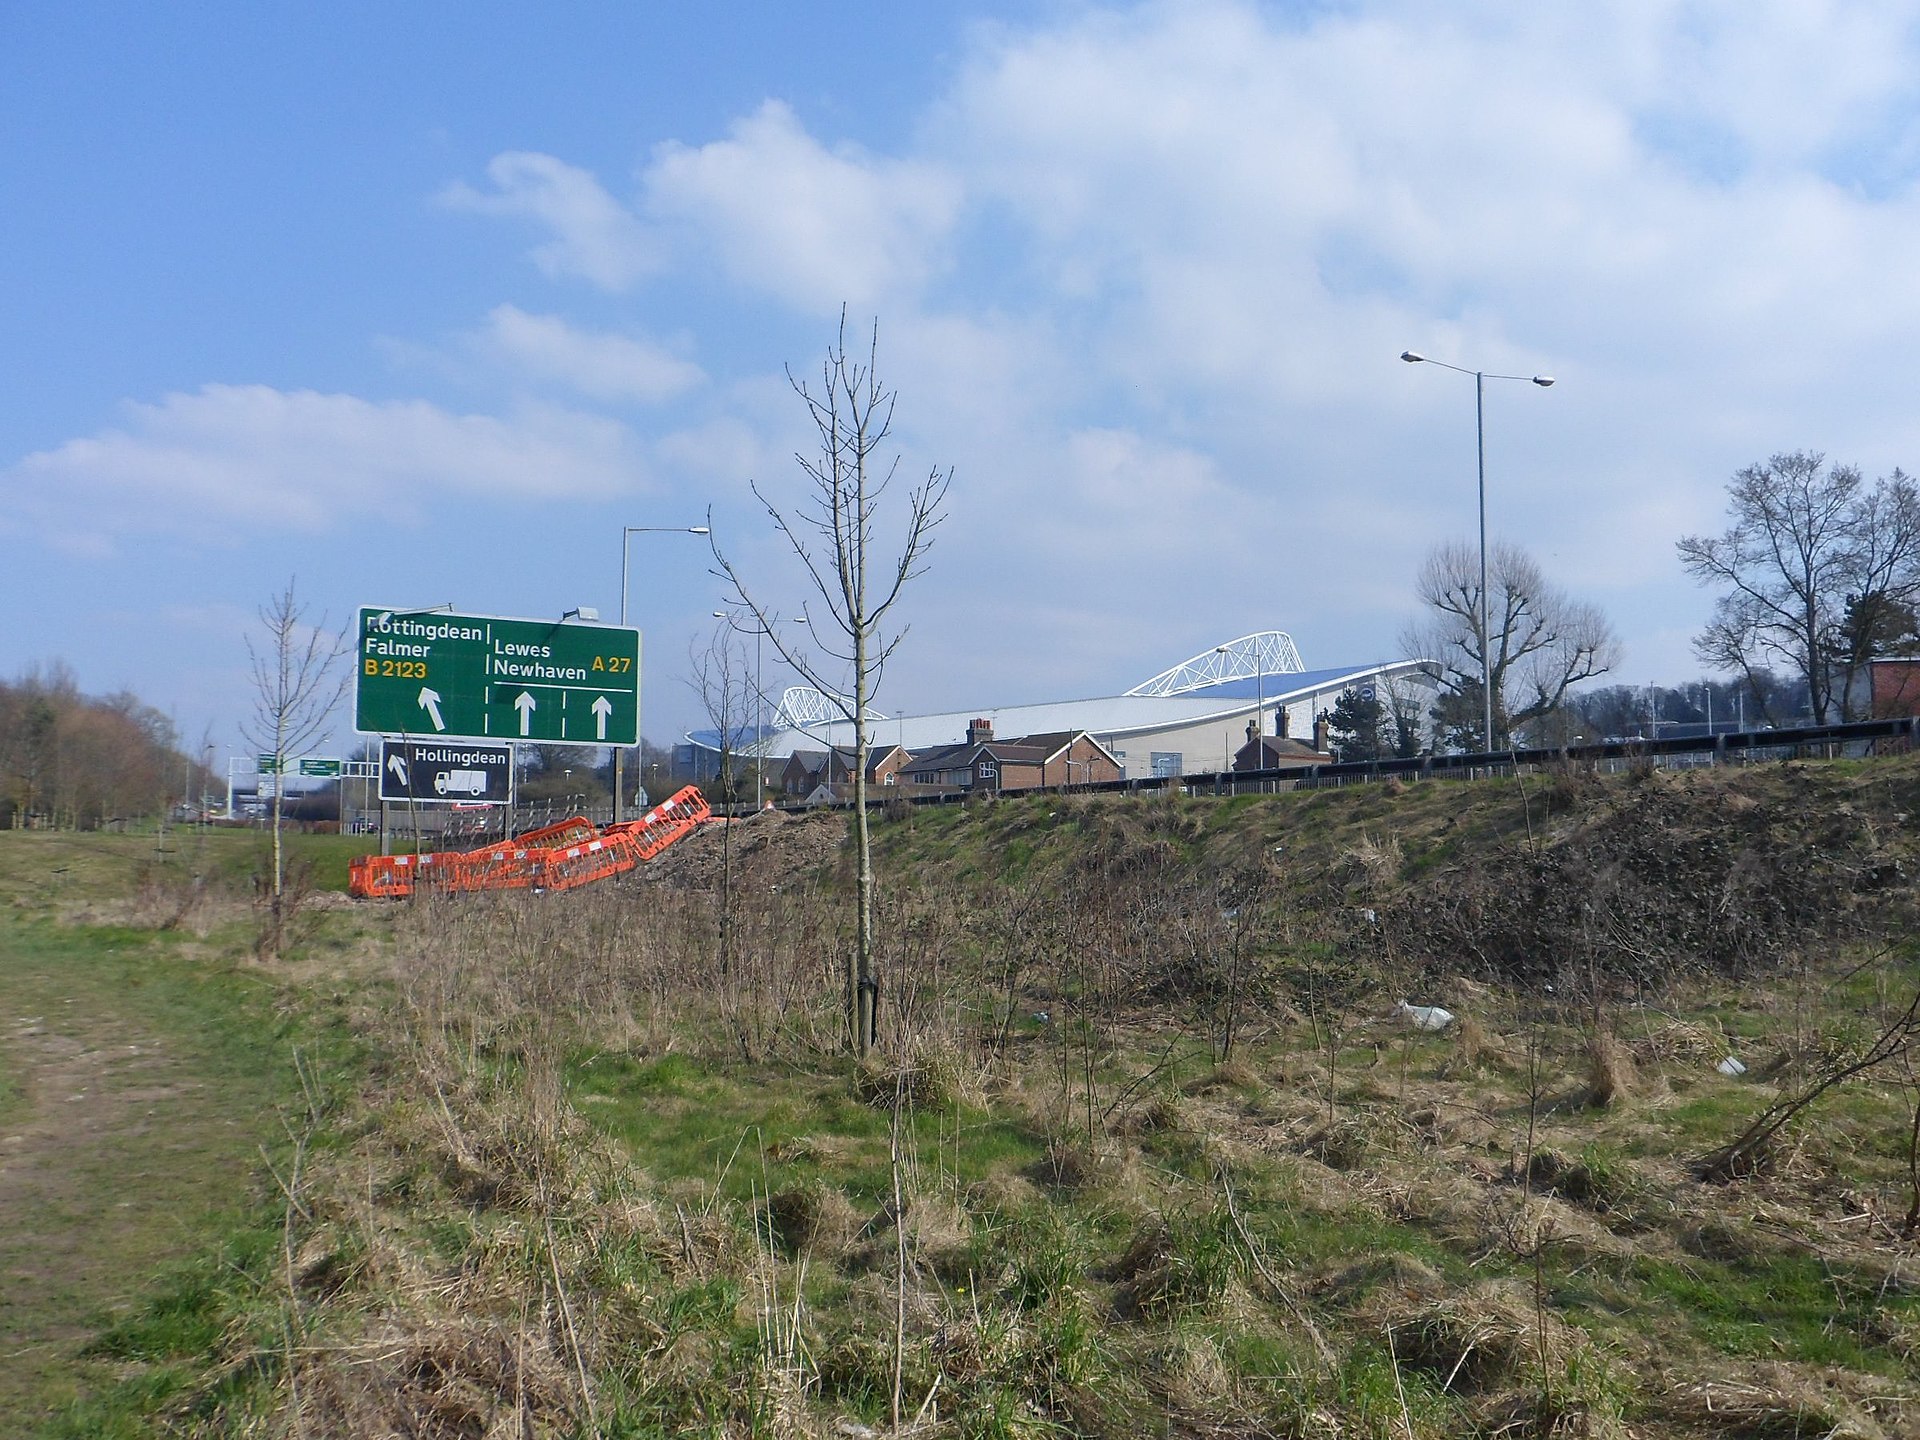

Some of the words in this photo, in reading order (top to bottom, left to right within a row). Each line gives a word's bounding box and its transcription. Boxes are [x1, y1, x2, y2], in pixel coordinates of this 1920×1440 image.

[365, 637, 431, 657] Falmer
[494, 638, 551, 658] Lewes
[364, 658, 378, 676] B
[382, 660, 427, 679] 2123
[493, 659, 587, 681] Newhaven
[591, 655, 605, 672] A
[608, 656, 632, 673] 27
[414, 748, 506, 766] Hollingdean
